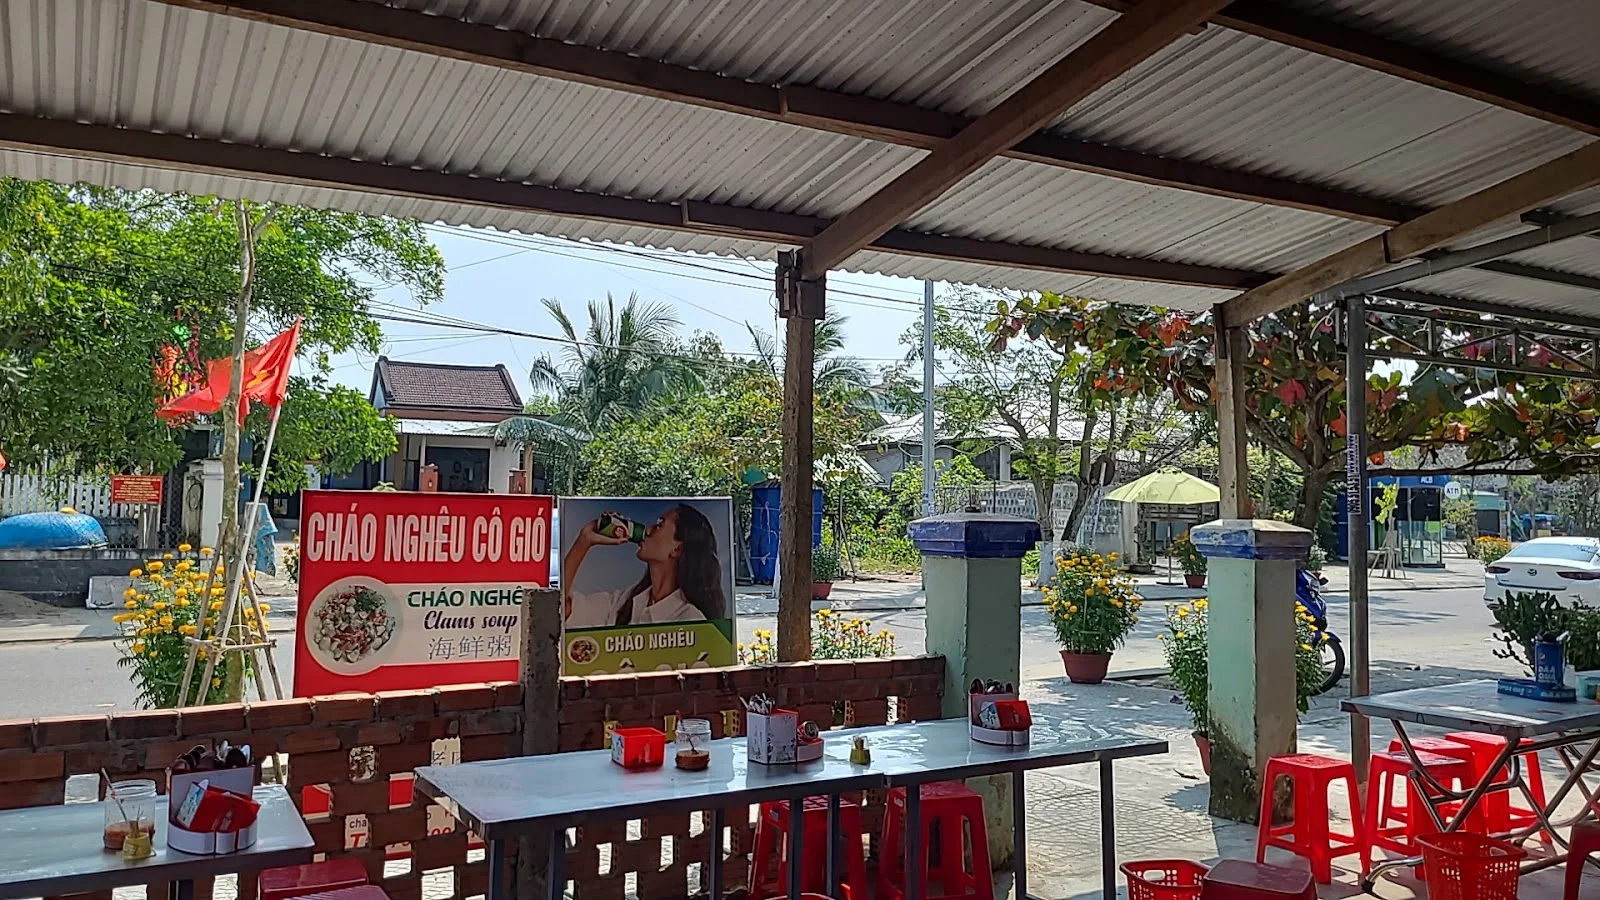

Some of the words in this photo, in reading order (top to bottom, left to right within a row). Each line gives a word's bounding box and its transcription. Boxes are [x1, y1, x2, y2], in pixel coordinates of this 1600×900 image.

[306, 503, 378, 562] CHÁO
[384, 505, 466, 562] NGHÊU
[472, 506, 504, 562] CÔ
[510, 507, 546, 562] GIÓ
[407, 586, 464, 607] CHÁO
[469, 585, 524, 606] NGHÊ
[424, 610, 476, 630] Clams
[481, 615, 518, 634] soup
[428, 635, 512, 660] 海鲜粥
[604, 631, 645, 653] CHÁO
[649, 627, 695, 650] NGHÊU
